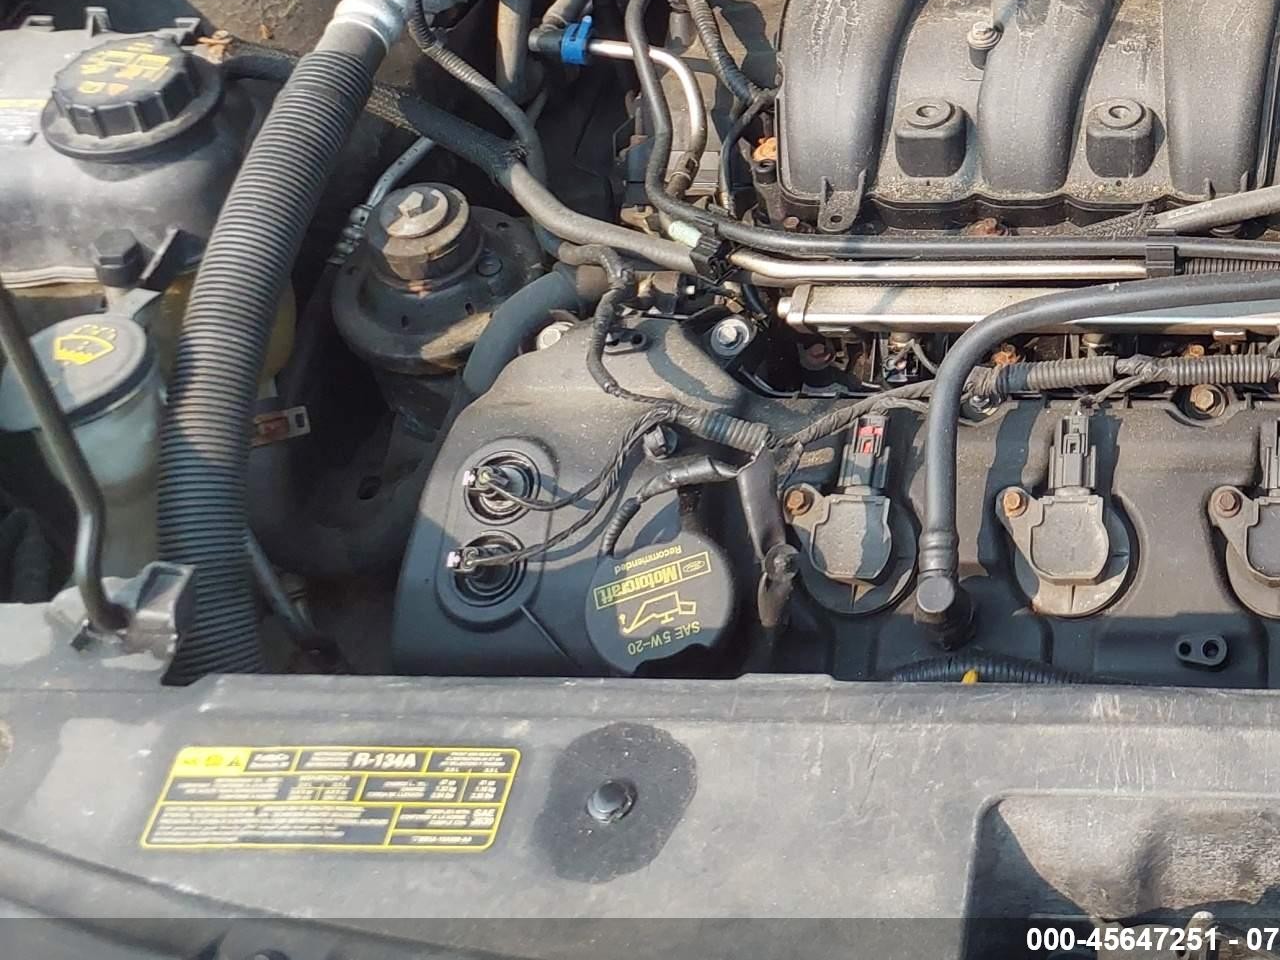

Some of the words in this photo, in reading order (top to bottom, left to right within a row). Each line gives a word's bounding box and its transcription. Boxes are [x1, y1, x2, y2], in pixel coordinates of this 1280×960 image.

[614, 545, 682, 576] Recommended
[598, 564, 680, 606] Motorcraft
[675, 620, 701, 640] SAE
[628, 632, 671, 656] 5W-20
[352, 752, 416, 769] R-134A
